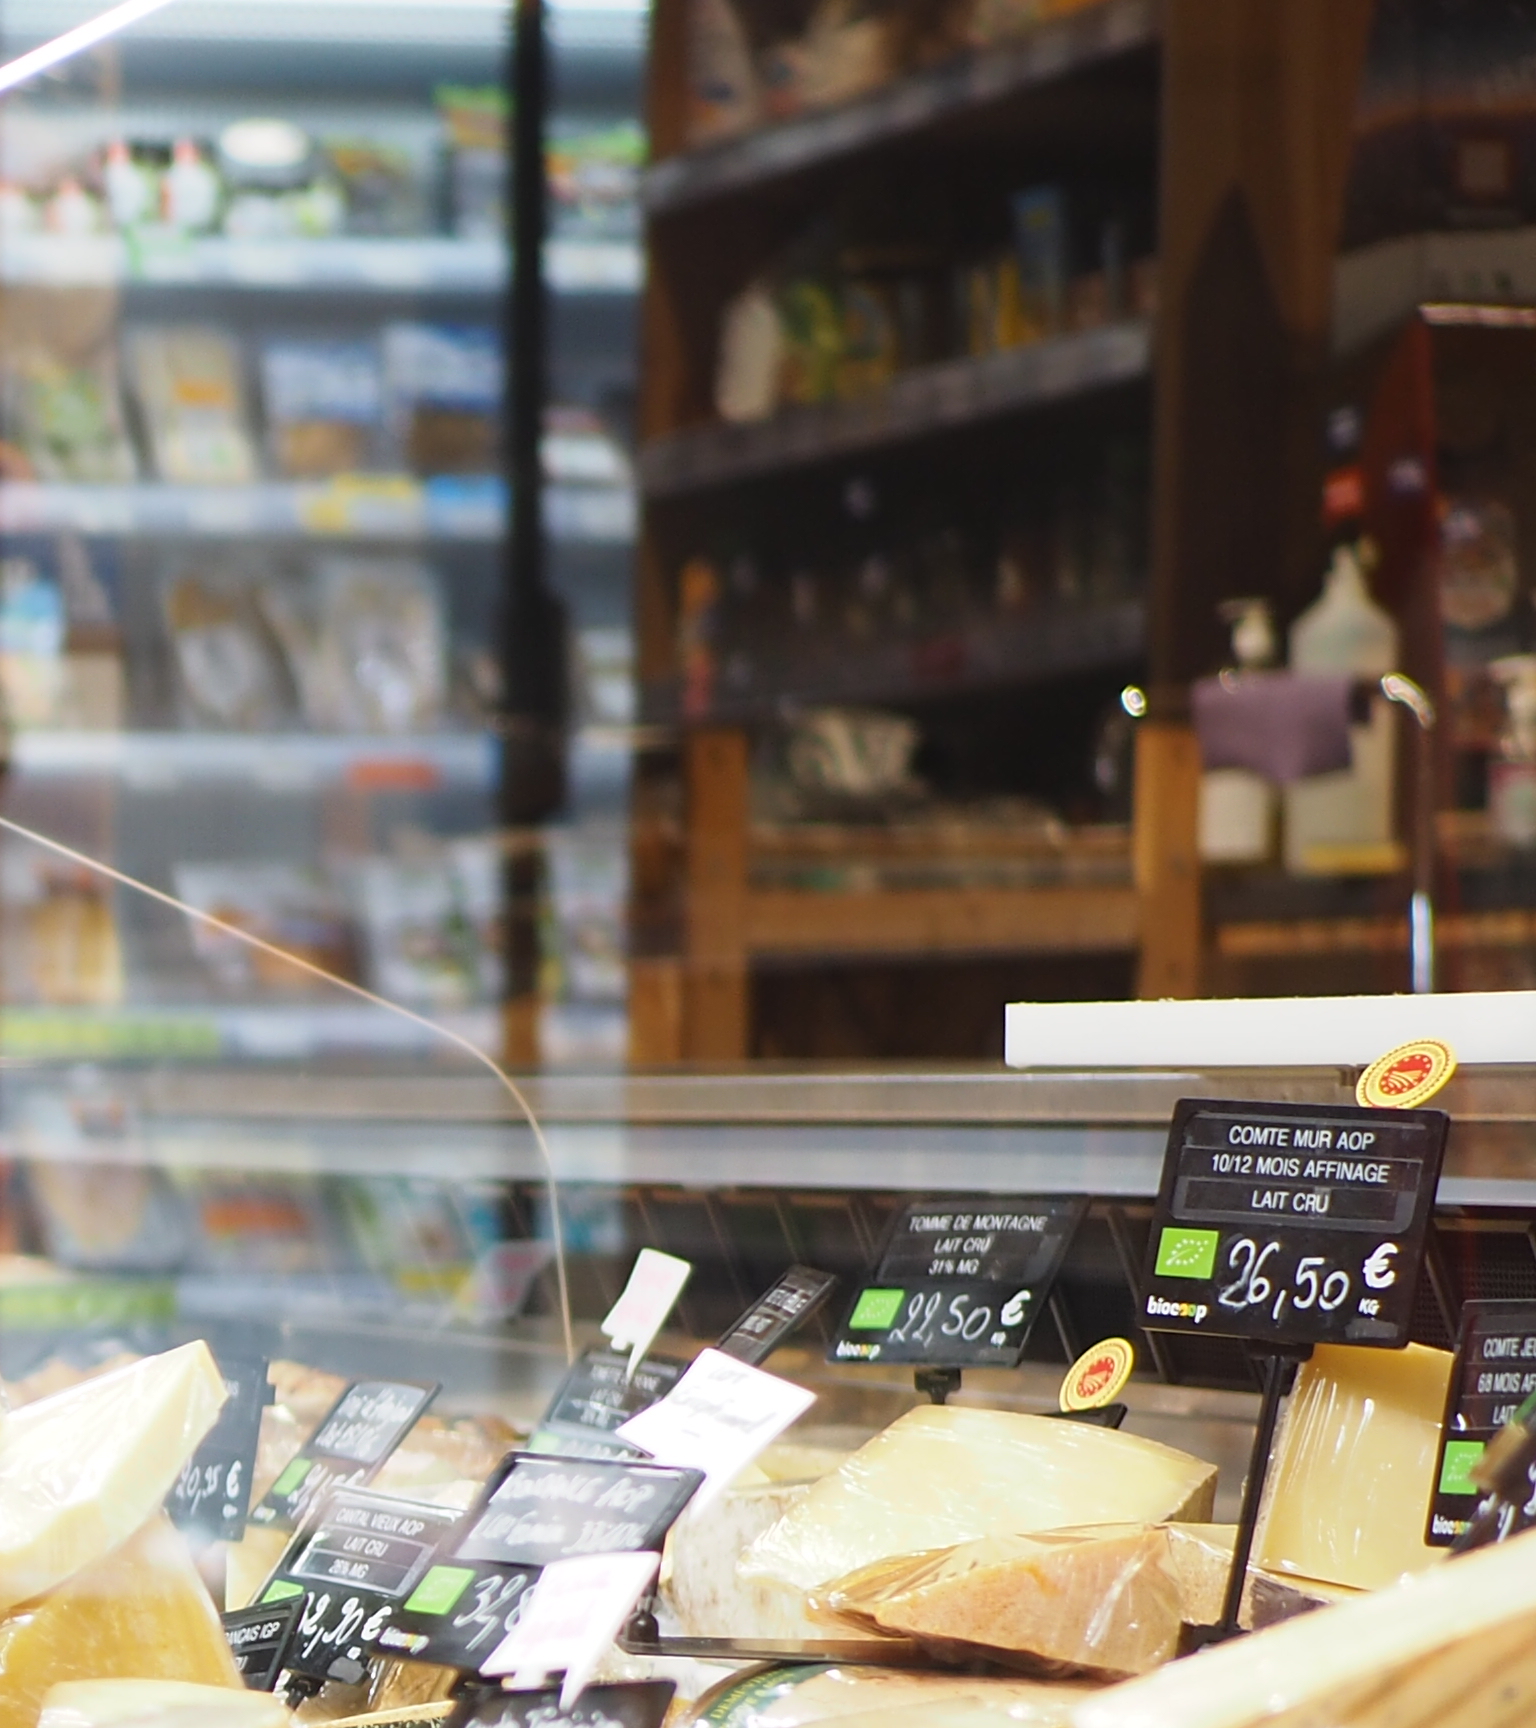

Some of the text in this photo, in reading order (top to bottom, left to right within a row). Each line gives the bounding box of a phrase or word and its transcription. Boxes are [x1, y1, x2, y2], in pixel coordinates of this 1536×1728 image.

[1228, 1125, 1375, 1151] COMTE MUR AOP
[1212, 1153, 1391, 1184] 10/12 MOIS AFFINAGE
[1251, 1190, 1330, 1213] LAIT CRU
[909, 1214, 1048, 1232] TOMME DE MONTAGNE
[934, 1237, 991, 1255] LAIT CRU
[956, 1258, 980, 1275] MG
[1218, 1237, 1399, 1320] 26,50 €
[1001, 1289, 1032, 1327] €
[1146, 1295, 1208, 1324] biocoop
[1483, 1337, 1520, 1357] COMTE
[1493, 1372, 1521, 1393] MOIS
[398, 1518, 425, 1536] AOP
[343, 1535, 389, 1557] LAIT CRU
[259, 1621, 281, 1639] IGP
[361, 1605, 392, 1641] €
